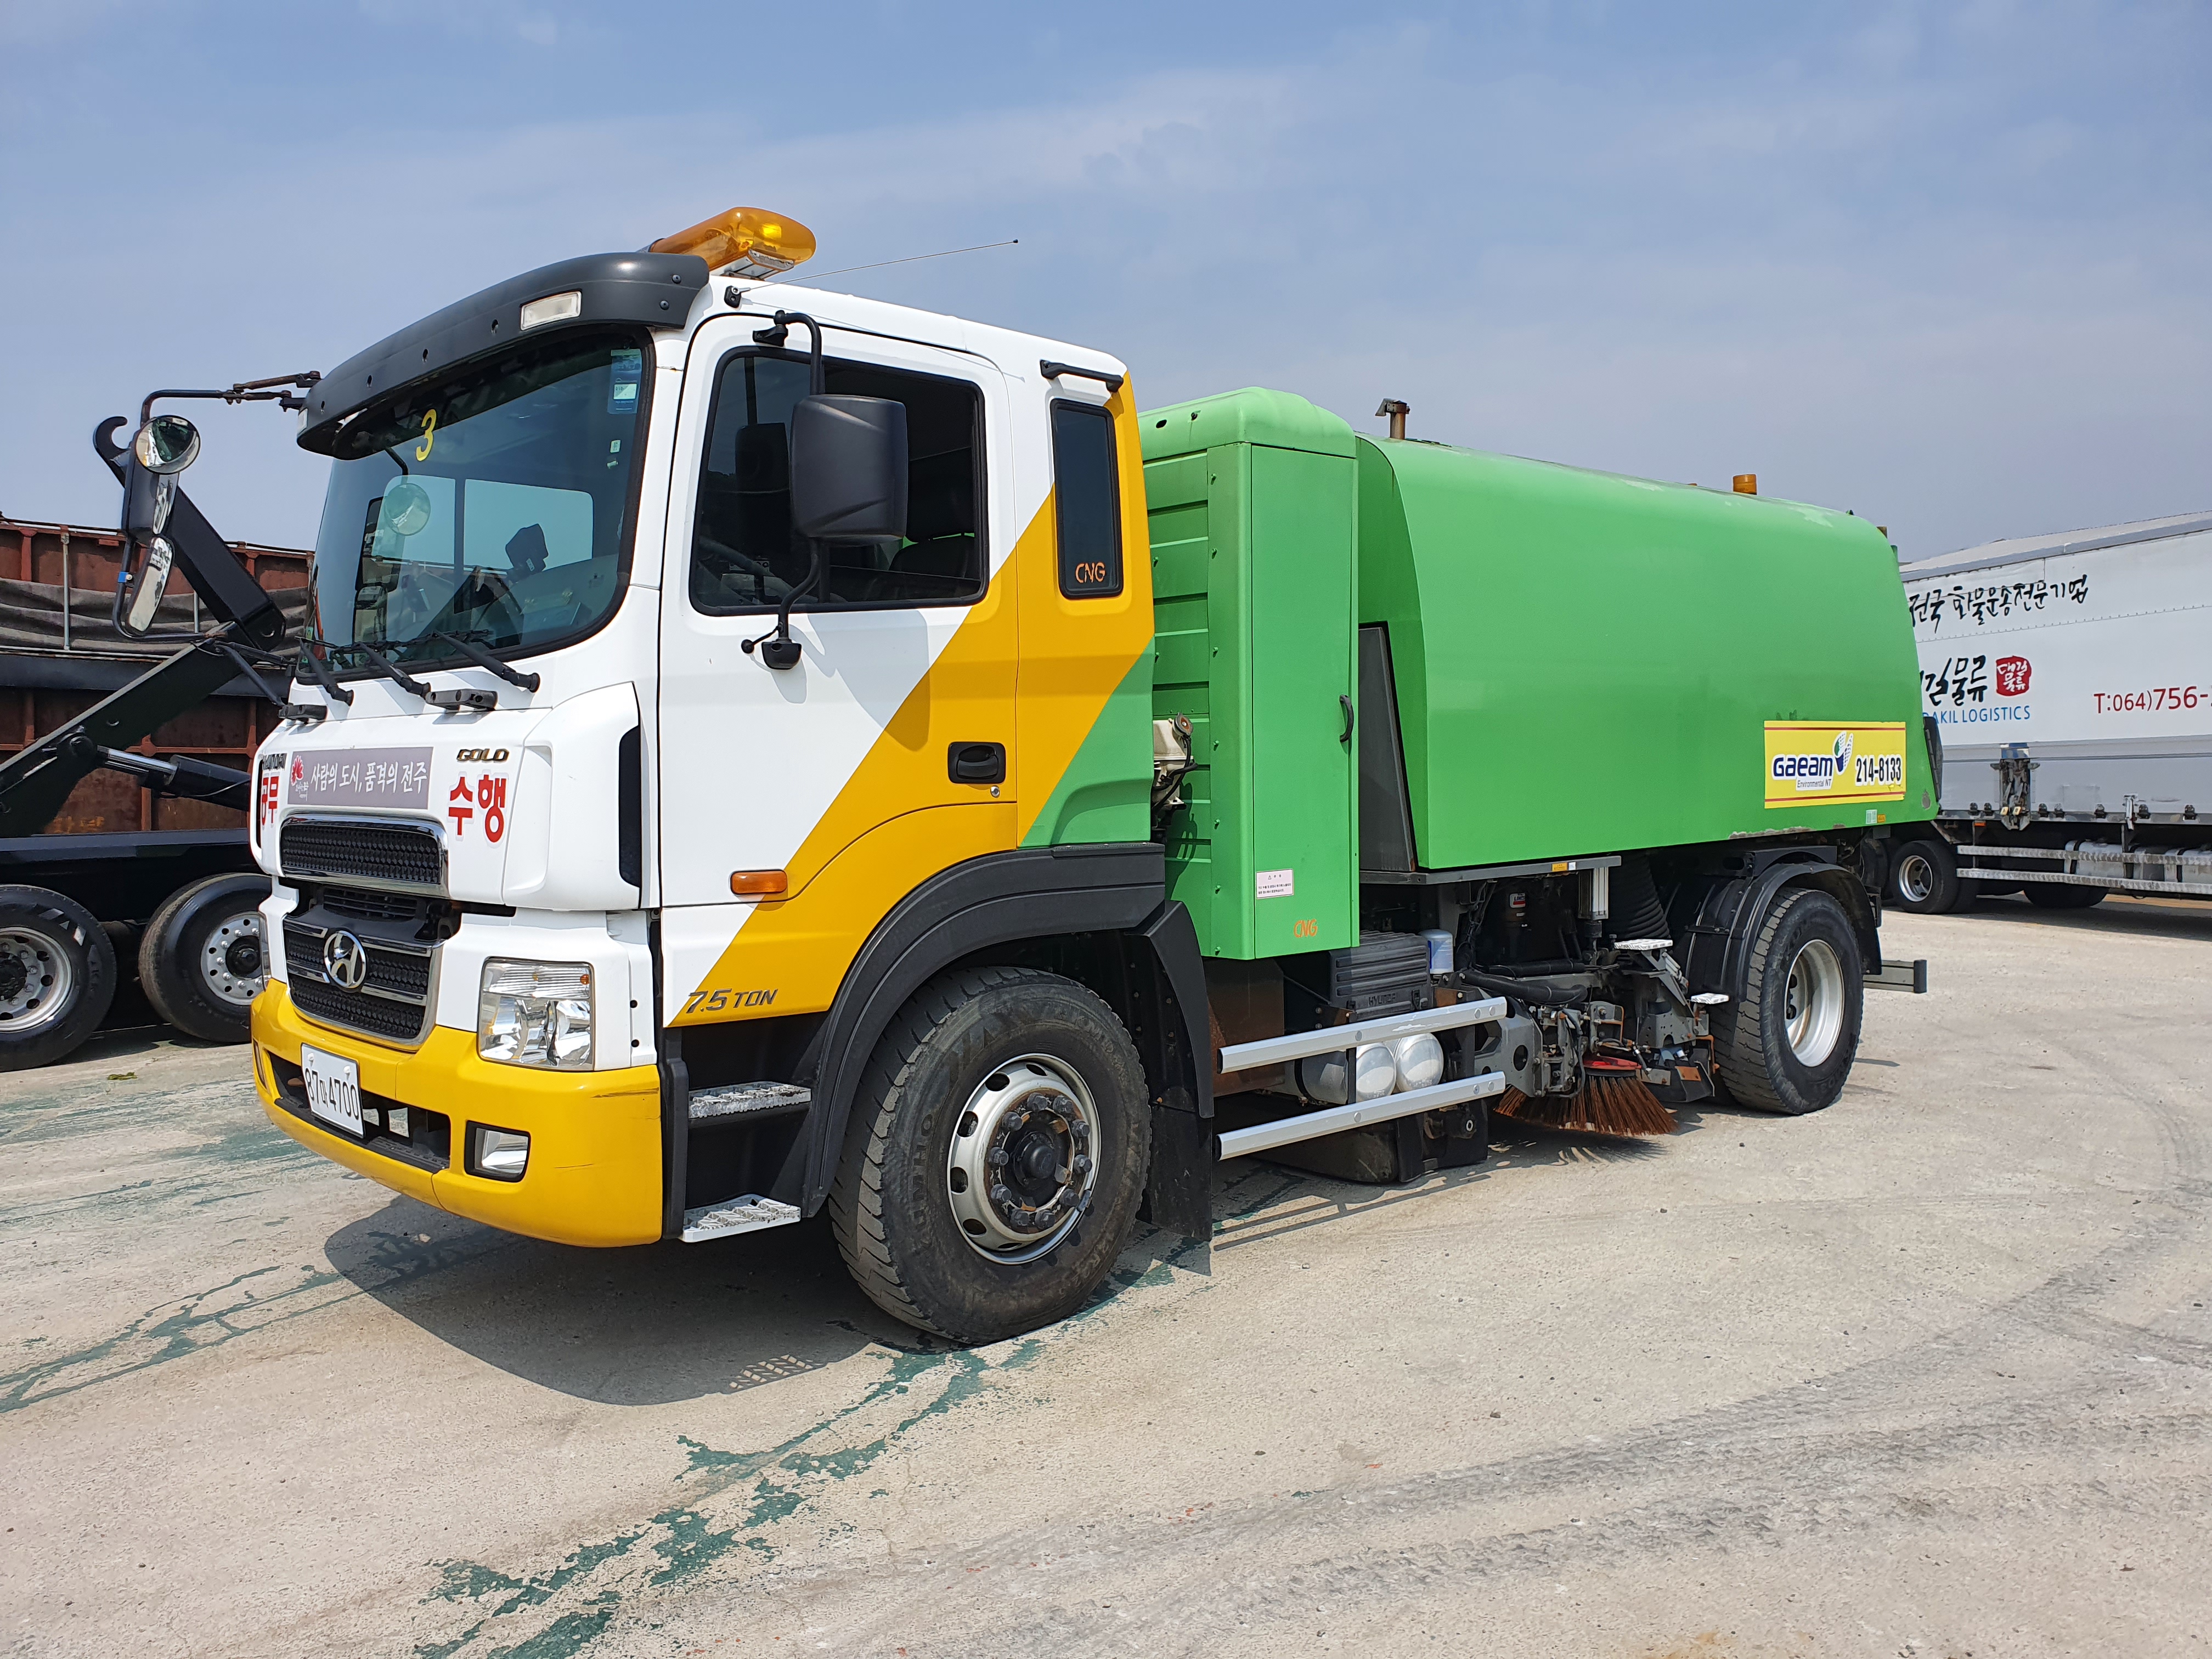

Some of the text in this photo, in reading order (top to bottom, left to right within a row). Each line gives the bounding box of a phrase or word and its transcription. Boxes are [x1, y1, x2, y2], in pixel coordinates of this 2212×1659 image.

[416, 409, 437, 461] 3
[1075, 562, 1105, 583] CNG
[1920, 655, 1988, 706] 길물류
[2094, 686, 2212, 714] T:064)756-
[1962, 706, 2030, 723] LOGISTICS
[456, 748, 509, 763] GOLD
[311, 762, 338, 792] 사람의
[364, 761, 398, 793] 품격의
[400, 761, 427, 794] 전주
[1856, 757, 1901, 782] 214-8133
[449, 775, 506, 843] 수행
[1294, 919, 1318, 938] CNG
[686, 989, 778, 1013] 7.5 TON
